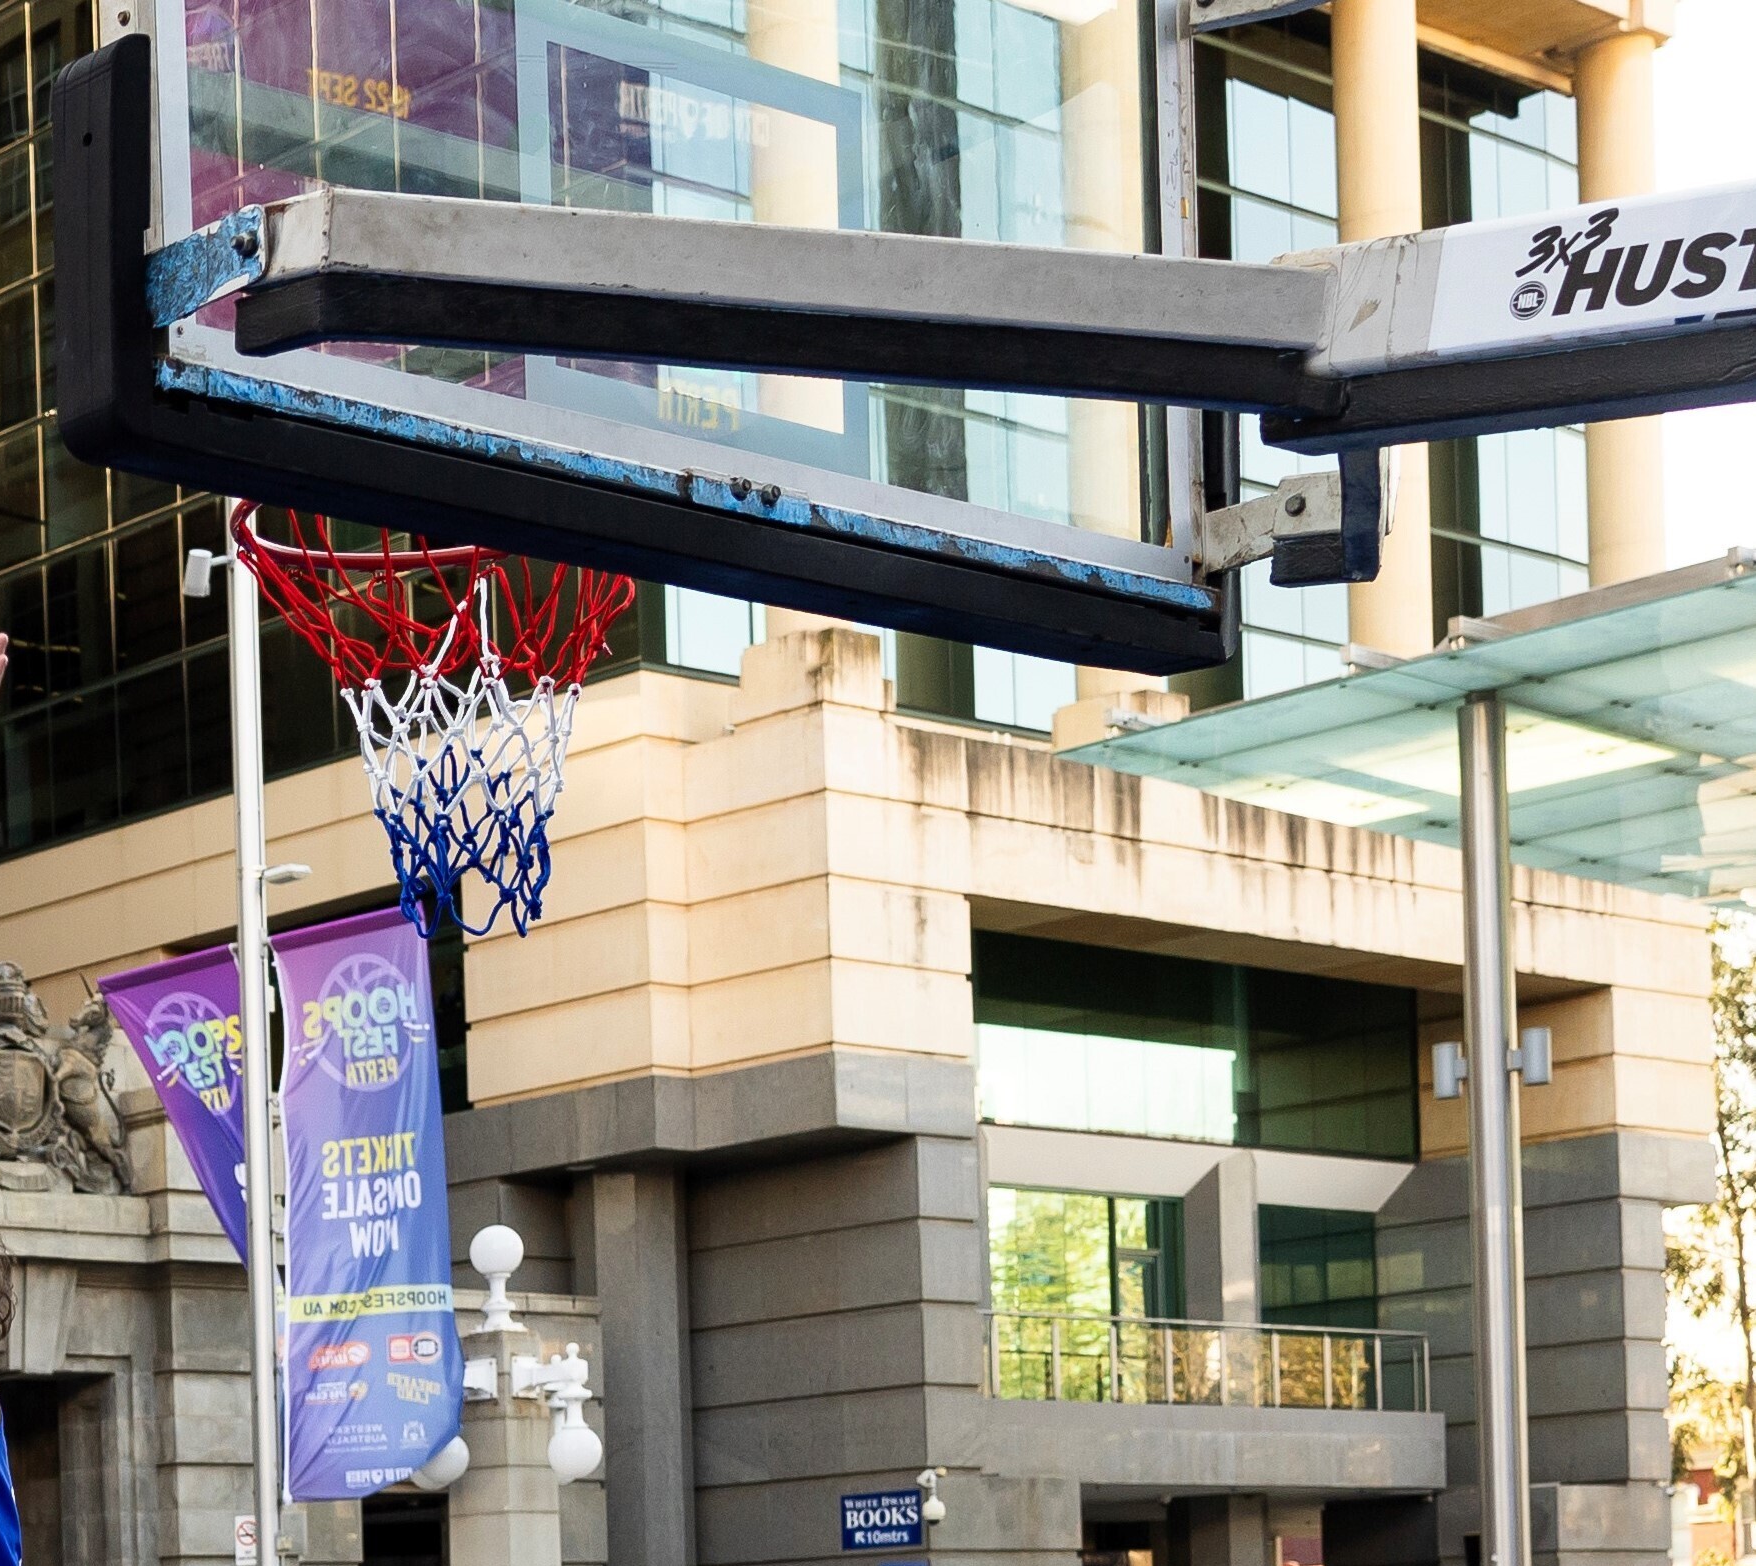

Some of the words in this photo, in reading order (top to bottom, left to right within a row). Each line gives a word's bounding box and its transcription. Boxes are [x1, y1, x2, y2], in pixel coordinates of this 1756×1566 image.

[1517, 290, 1539, 309] NBL
[179, 1054, 225, 1089] EST
[846, 1506, 919, 1529] BOOKS
